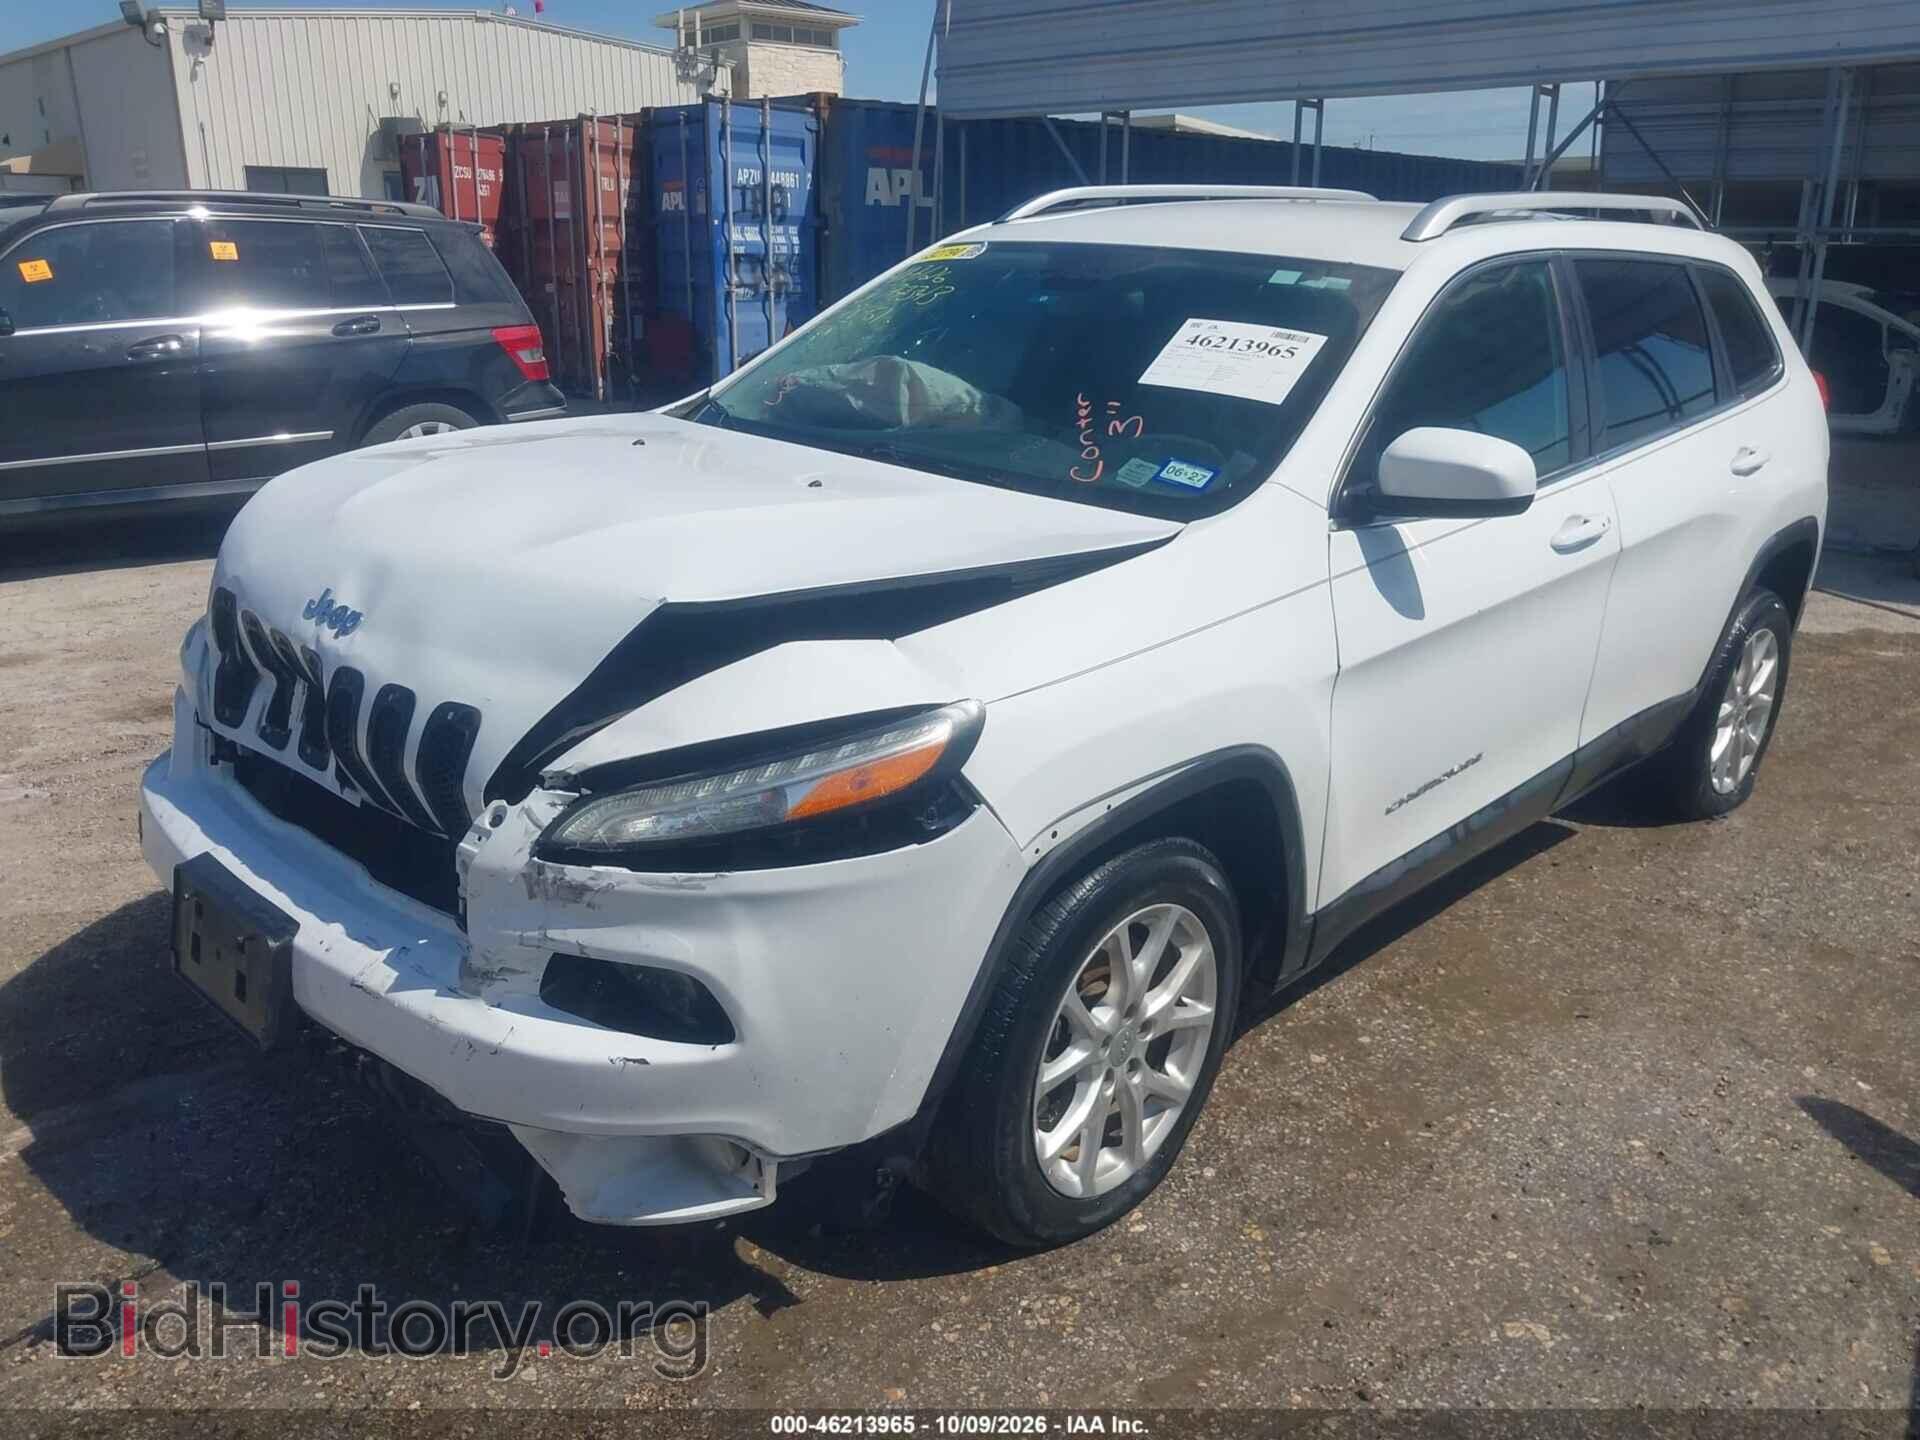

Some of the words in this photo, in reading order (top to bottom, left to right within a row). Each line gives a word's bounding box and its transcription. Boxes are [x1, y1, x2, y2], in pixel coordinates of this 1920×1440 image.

[737, 168, 763, 185] APZU
[865, 168, 937, 207] APL
[662, 191, 685, 211] APL
[1186, 333, 1299, 360] 46213965
[303, 588, 363, 640] Jeep
